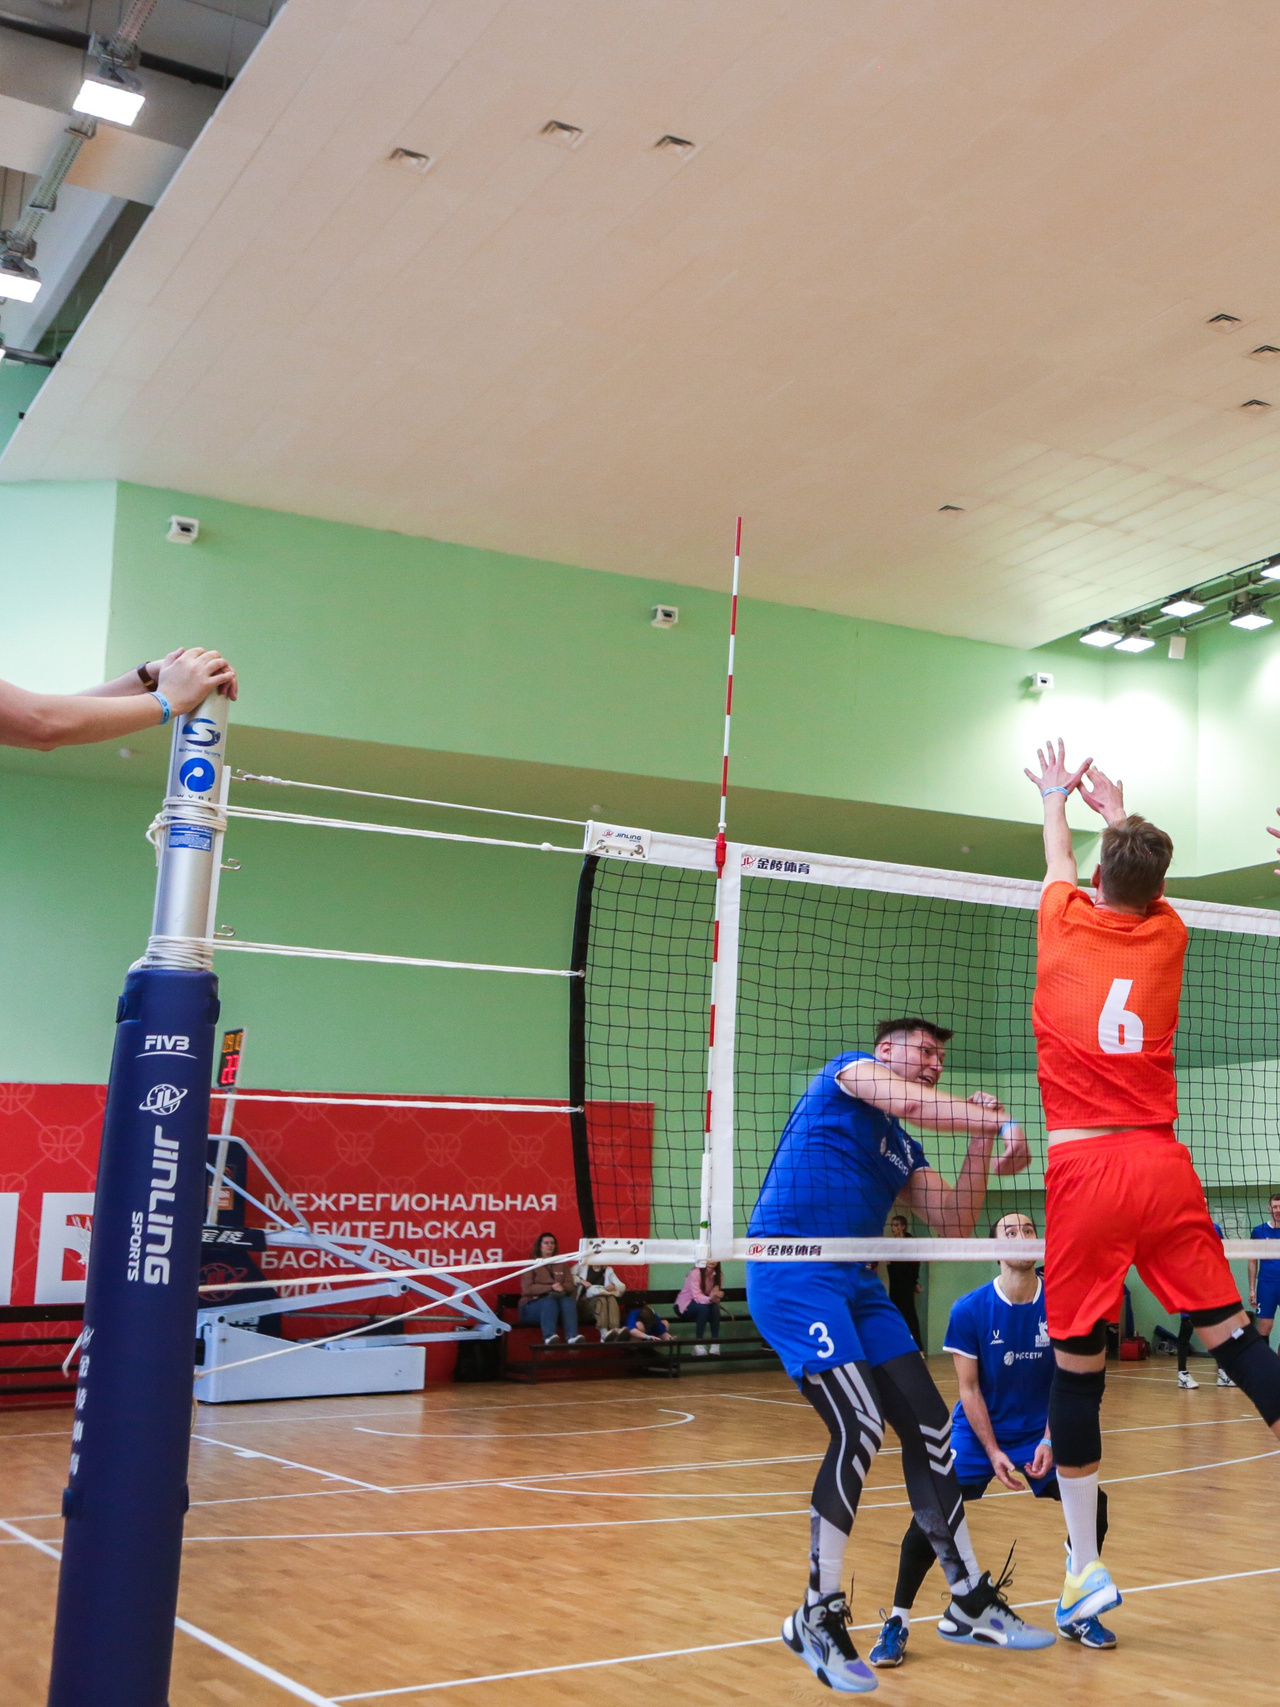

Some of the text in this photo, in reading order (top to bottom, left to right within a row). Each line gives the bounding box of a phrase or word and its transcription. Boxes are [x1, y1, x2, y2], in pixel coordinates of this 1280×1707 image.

[757, 857, 810, 875] 金陵体育
[1098, 978, 1144, 1054] 6
[144, 1034, 190, 1052] FIVB
[264, 1193, 558, 1212] МЕЖРЕГИОНАЛЬНАЯ
[264, 1221, 497, 1240] ЛБИТЕЛЬСКАЯ
[127, 1211, 144, 1283] SPORTS
[260, 1248, 504, 1270] БАСКБОЛЬНАЯ
[808, 1321, 836, 1359] 3
